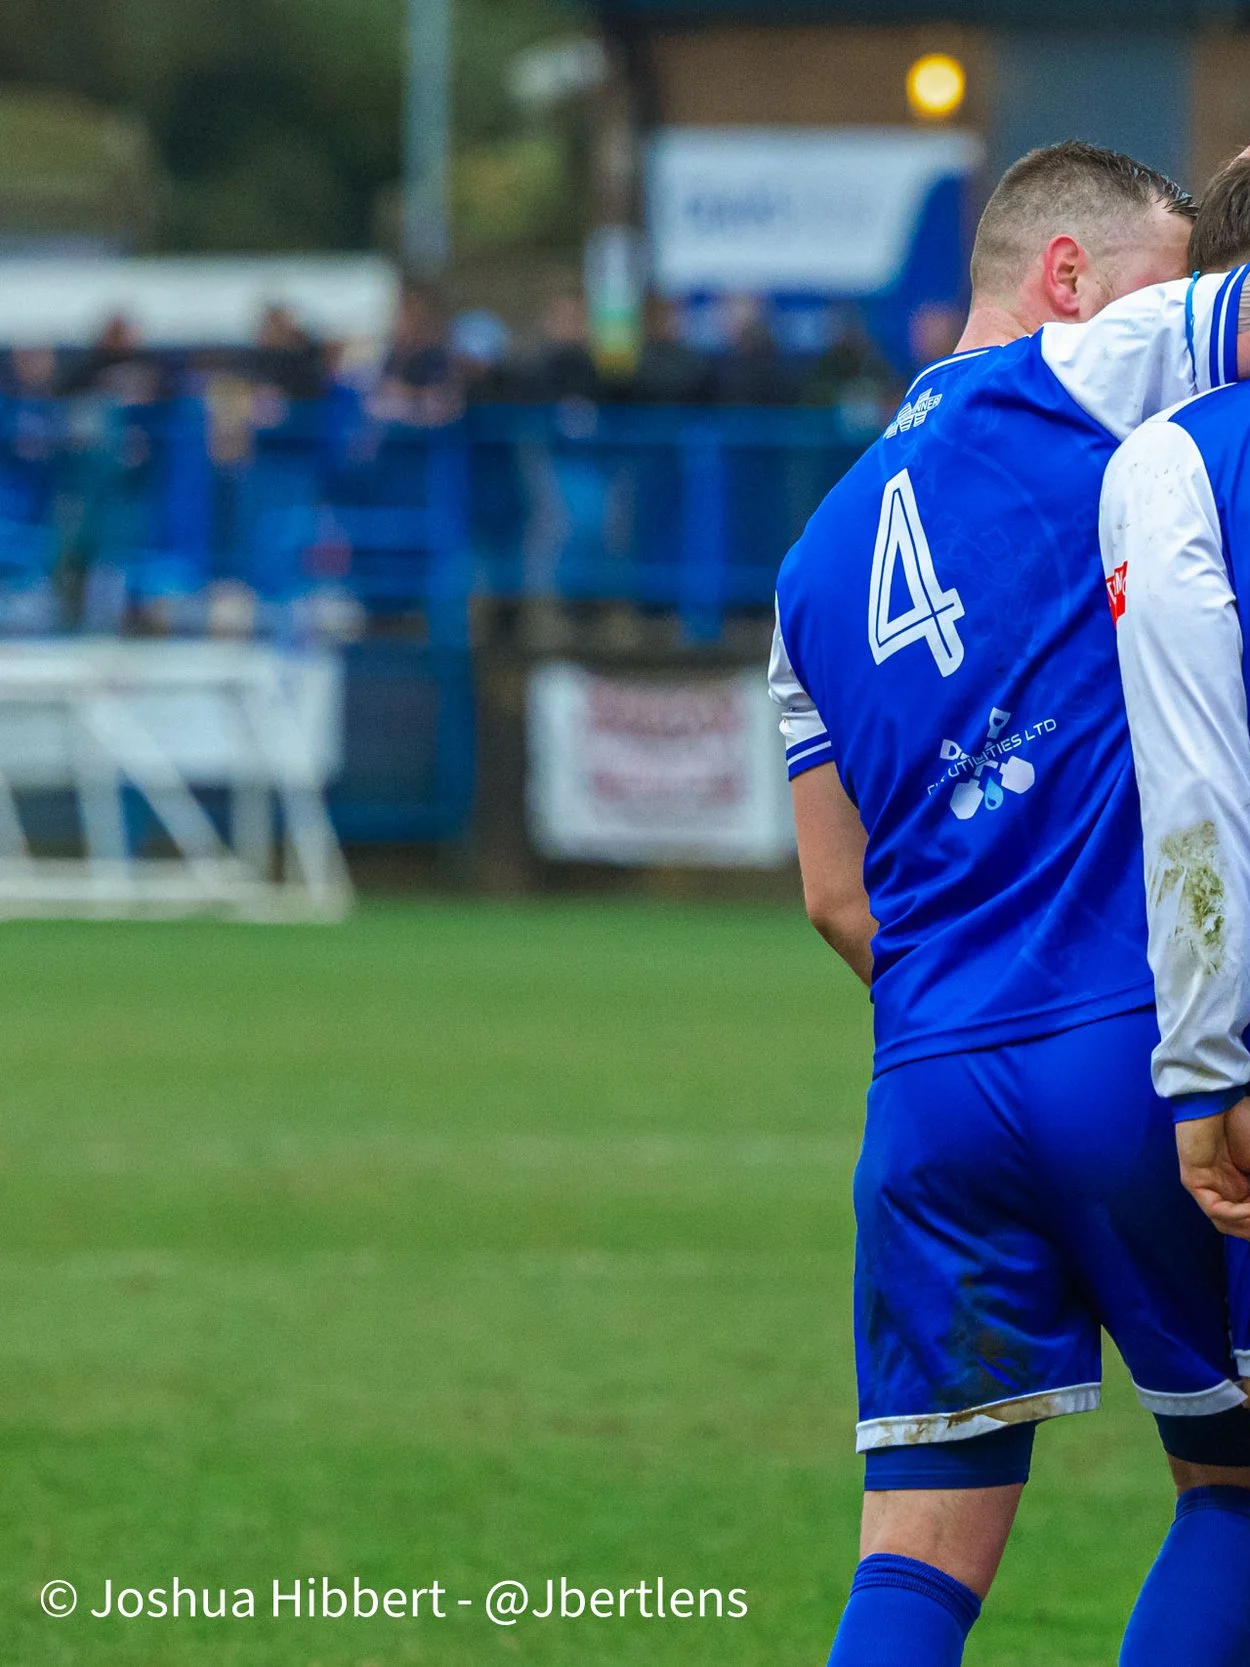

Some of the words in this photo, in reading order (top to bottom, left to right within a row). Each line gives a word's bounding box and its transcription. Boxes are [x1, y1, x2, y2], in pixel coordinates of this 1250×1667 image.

[868, 467, 965, 678] 4
[948, 733, 1022, 777] UTILITIES
[1025, 718, 1057, 741] LTD
